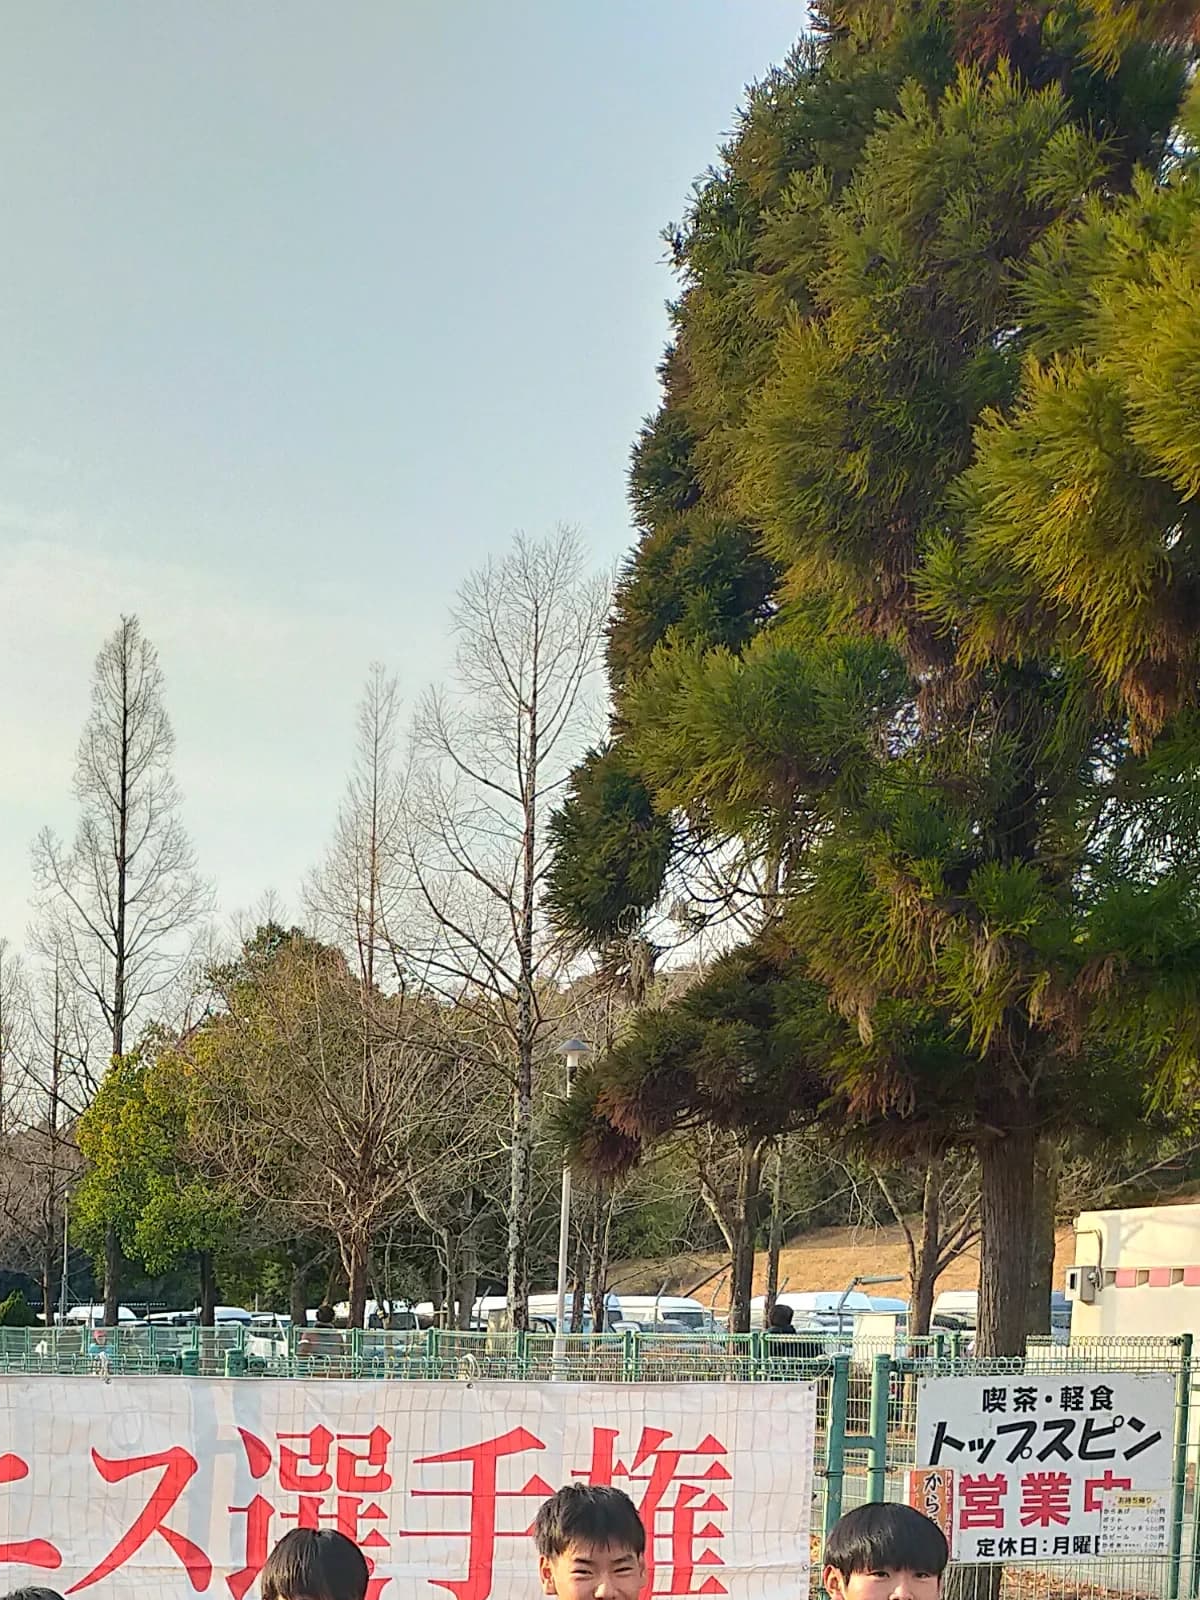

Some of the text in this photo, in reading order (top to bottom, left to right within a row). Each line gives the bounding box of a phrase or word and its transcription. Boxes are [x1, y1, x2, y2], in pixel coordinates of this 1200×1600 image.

[982, 1385, 1114, 1413] 喫茶・軽食
[929, 1415, 1162, 1466] トップスピン
[924, 1472, 943, 1525] から
